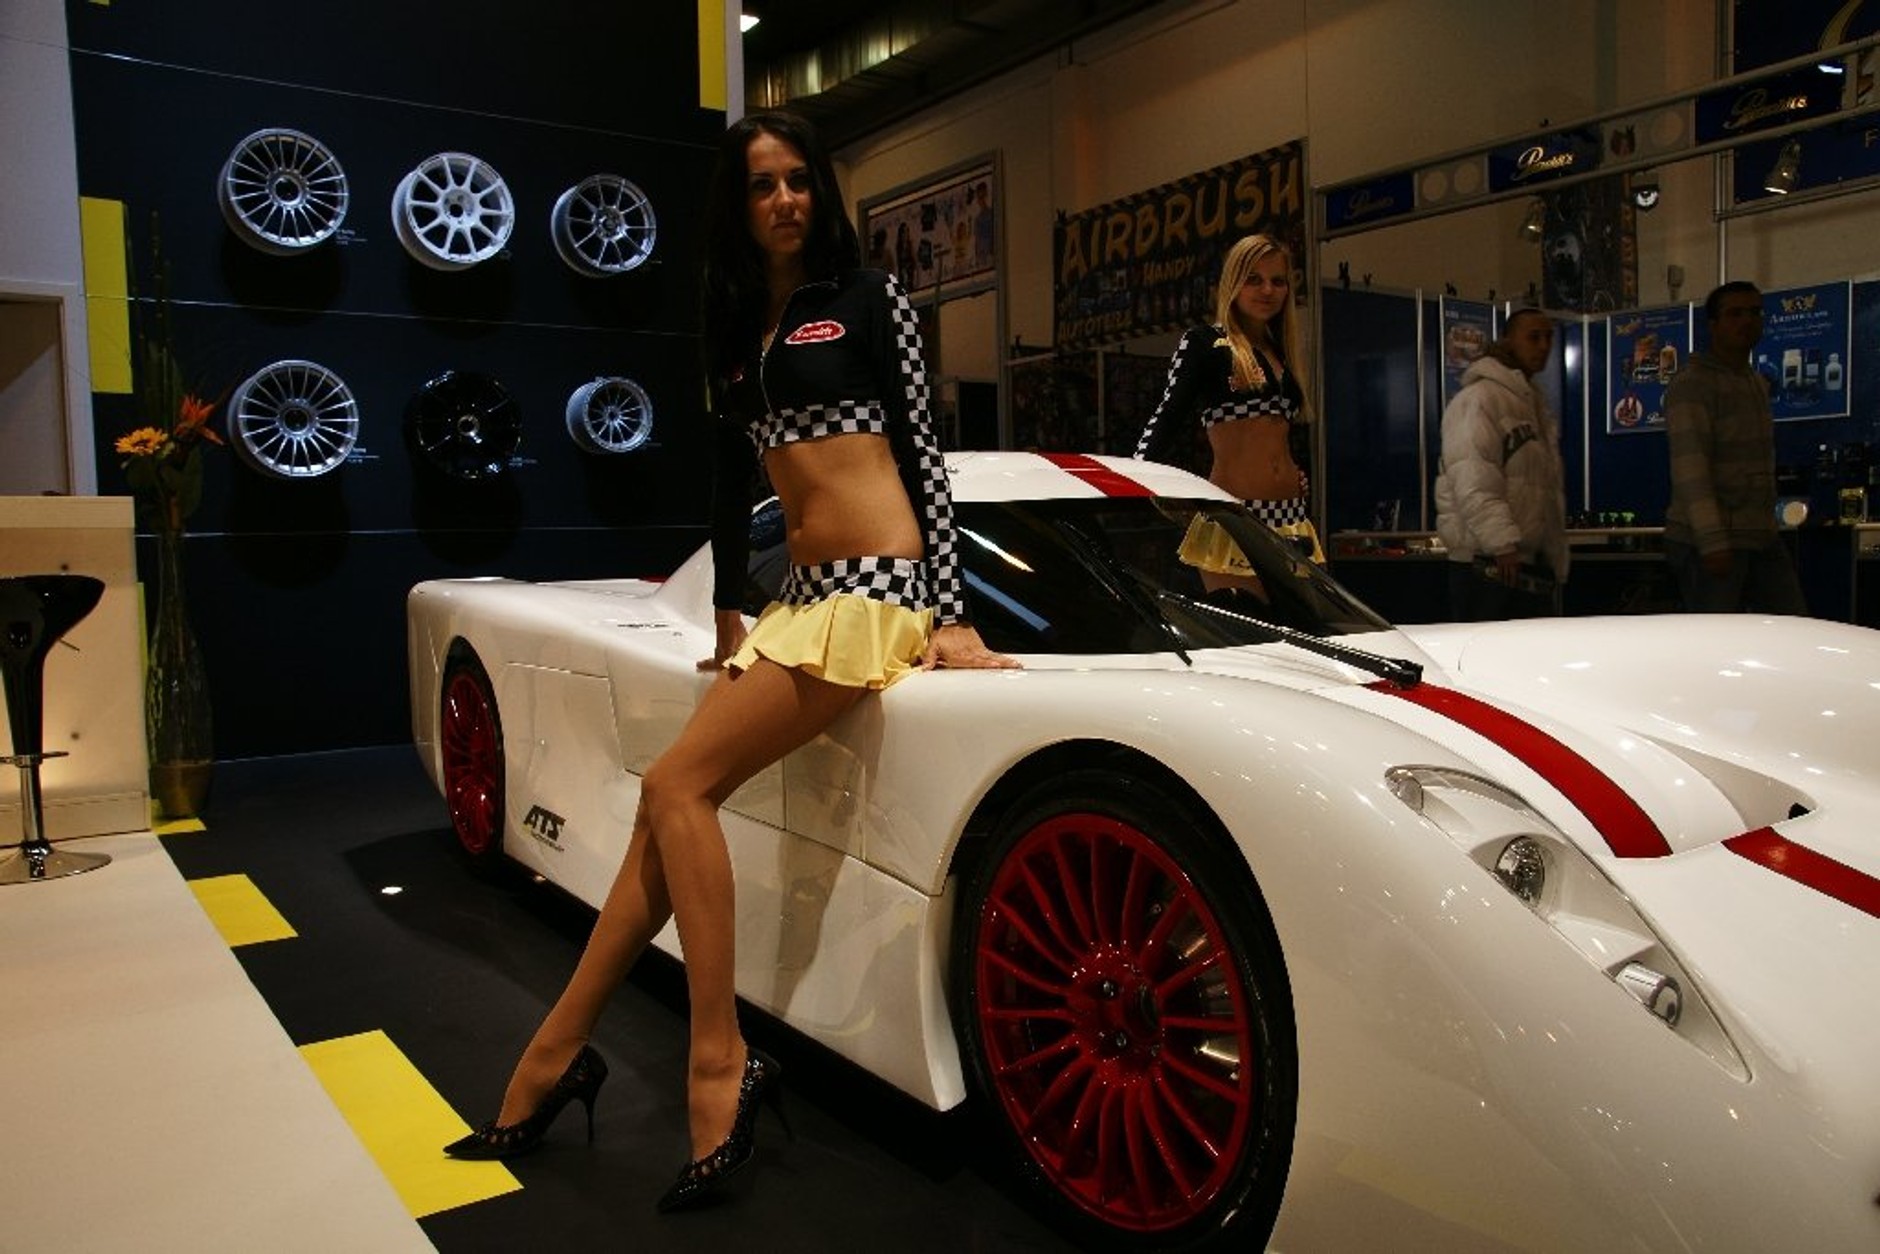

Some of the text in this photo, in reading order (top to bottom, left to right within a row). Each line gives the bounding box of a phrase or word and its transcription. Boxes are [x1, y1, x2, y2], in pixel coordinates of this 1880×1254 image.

[1061, 157, 1299, 290] AIRBRUSH
[1143, 255, 1196, 288] HANDY
[523, 805, 566, 841] ATS
